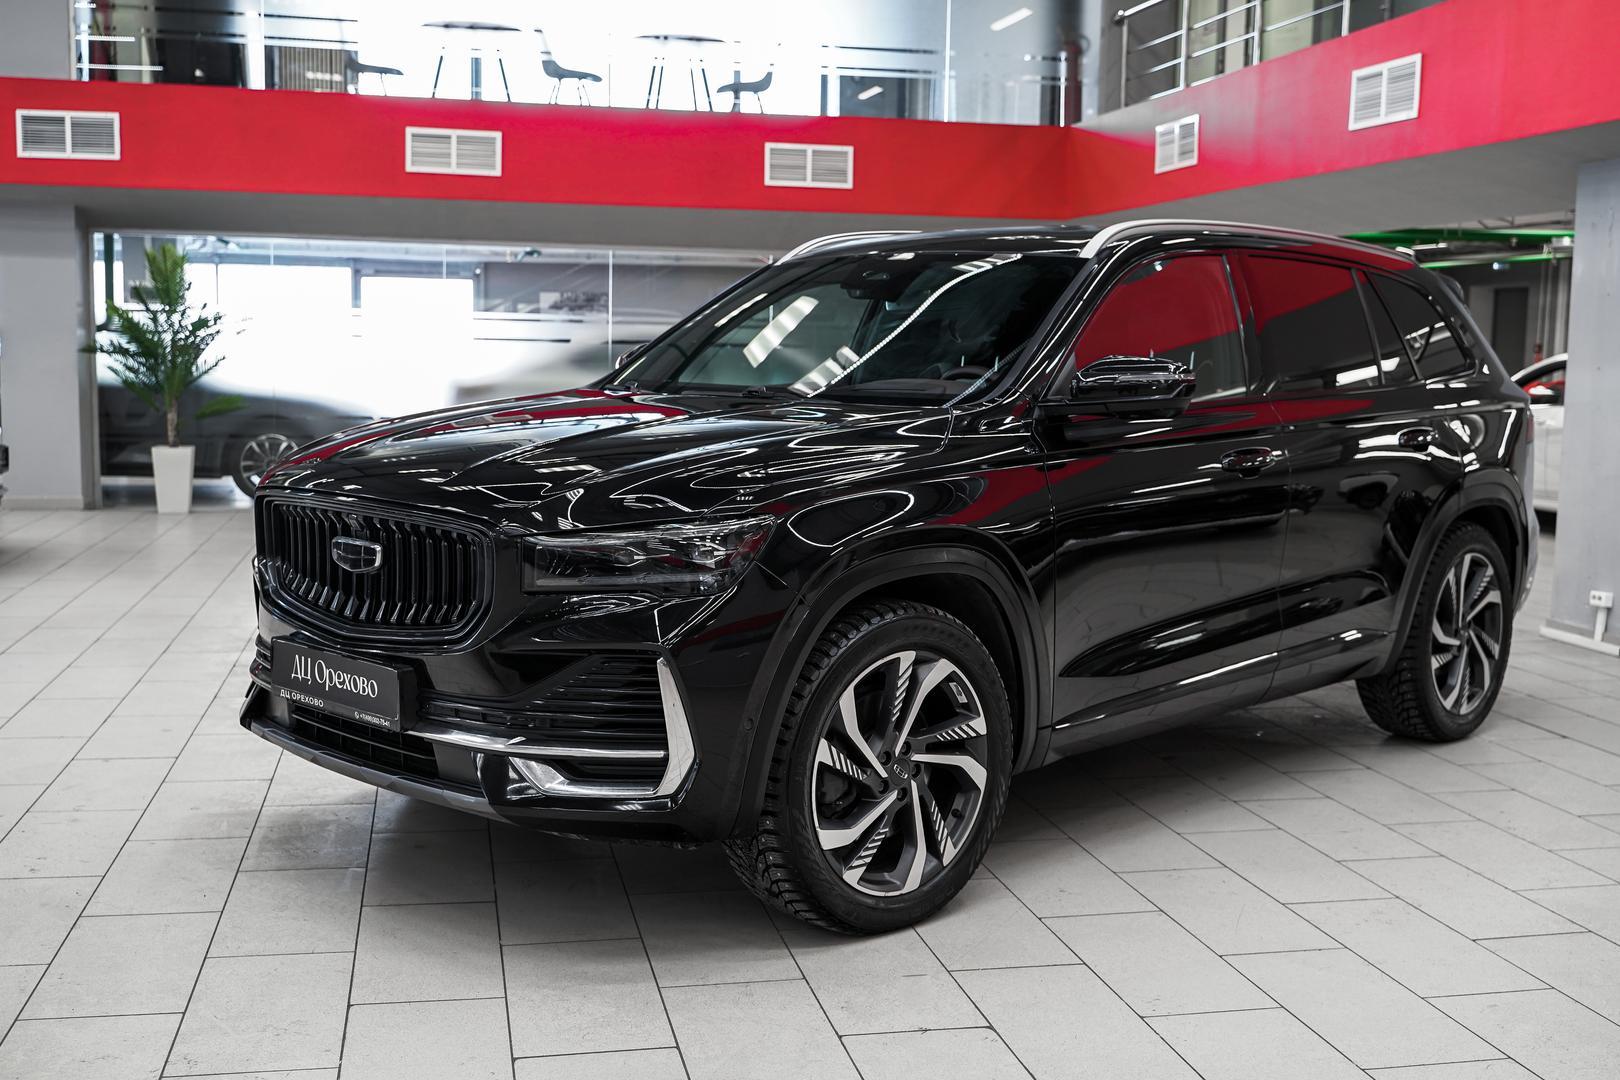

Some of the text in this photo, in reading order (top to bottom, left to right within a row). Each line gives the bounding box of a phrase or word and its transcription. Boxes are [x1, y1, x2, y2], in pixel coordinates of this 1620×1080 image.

[291, 654, 378, 698] ДЦ Орехово
[280, 689, 324, 708] ДЦ ОРЕХОВО
